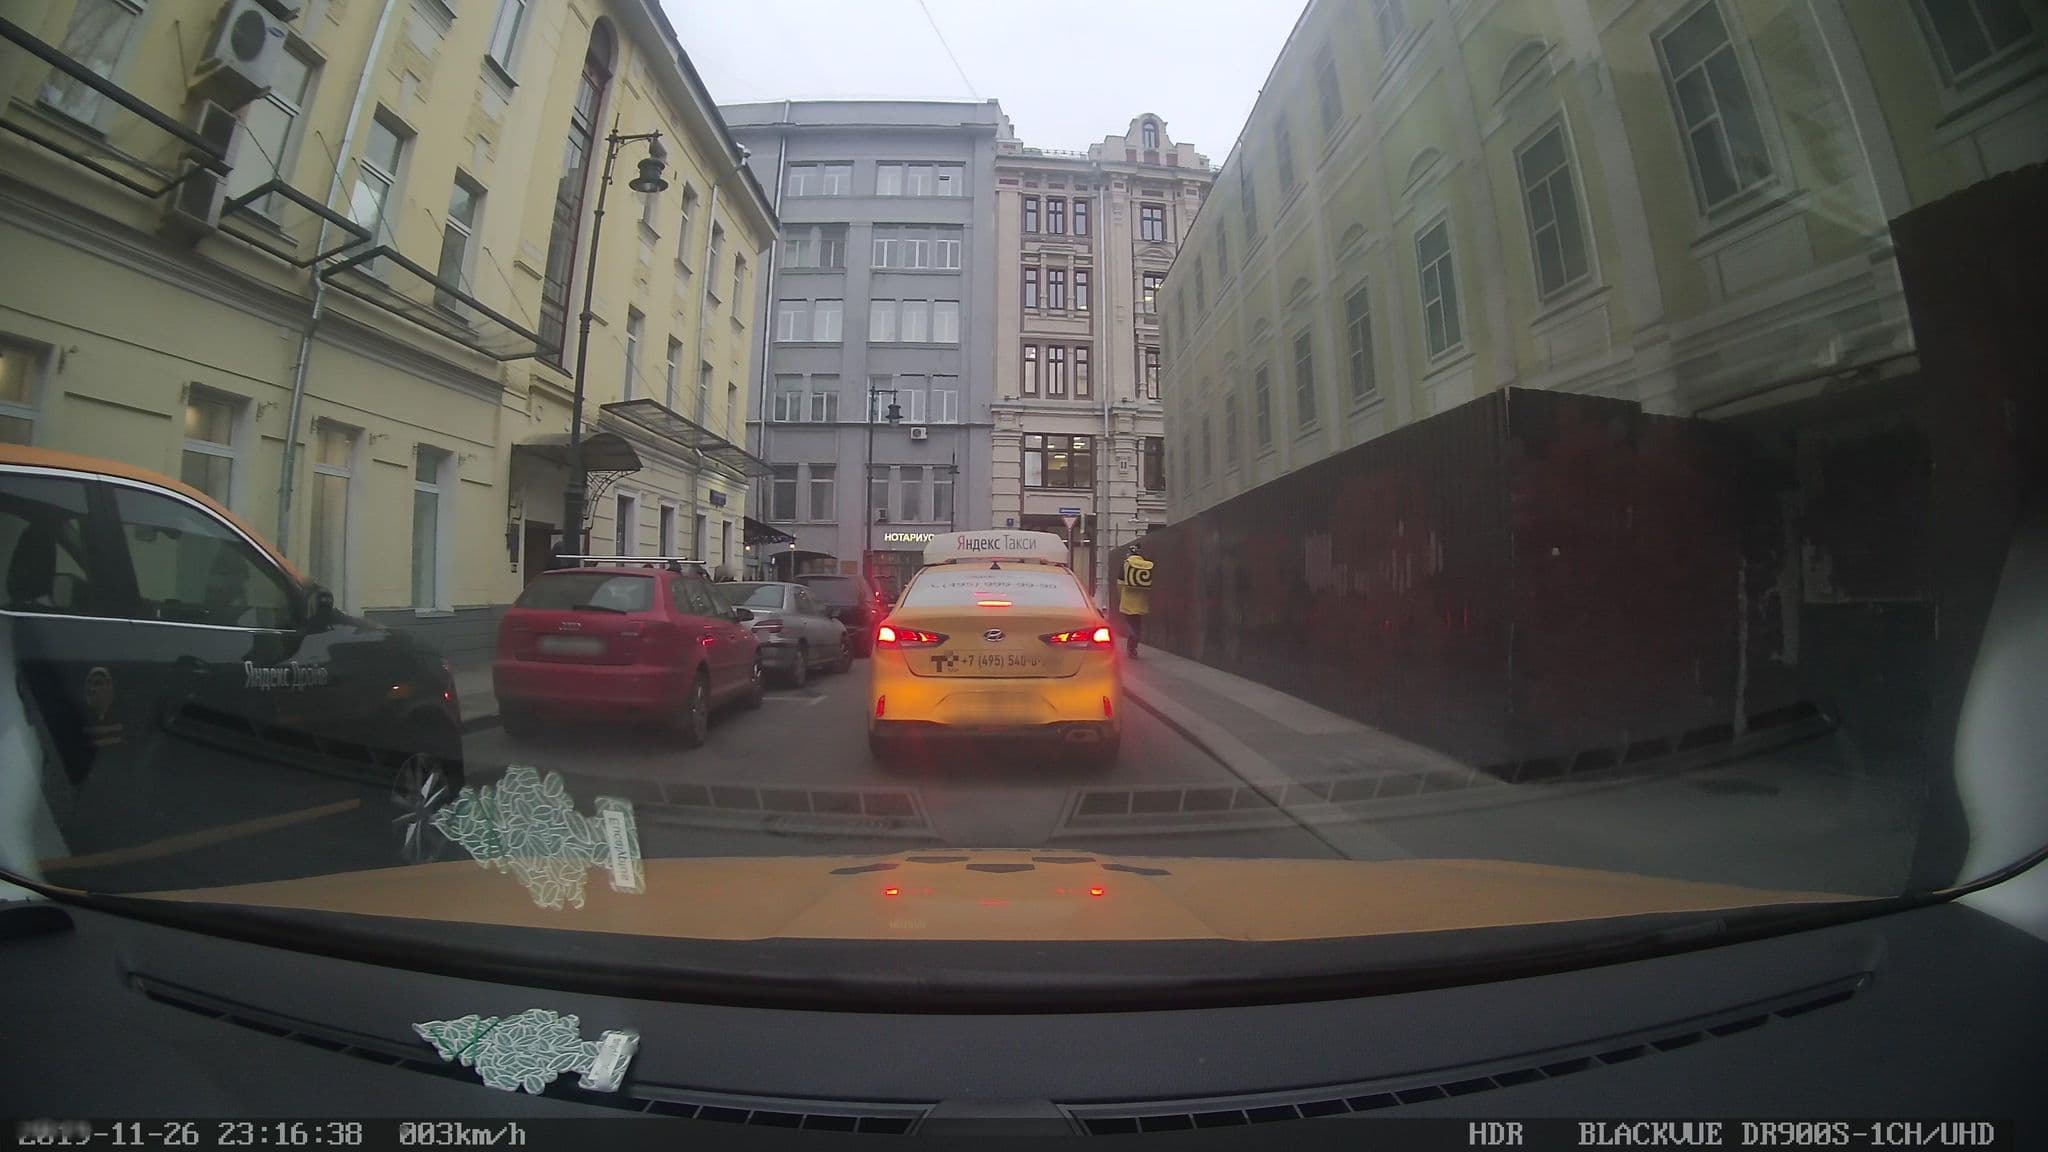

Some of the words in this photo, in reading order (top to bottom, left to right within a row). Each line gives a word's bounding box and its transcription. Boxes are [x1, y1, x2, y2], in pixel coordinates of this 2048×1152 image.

[957, 535, 1001, 551] Яндекс
[1004, 534, 1037, 550] Такси
[978, 654, 1004, 667] (495)
